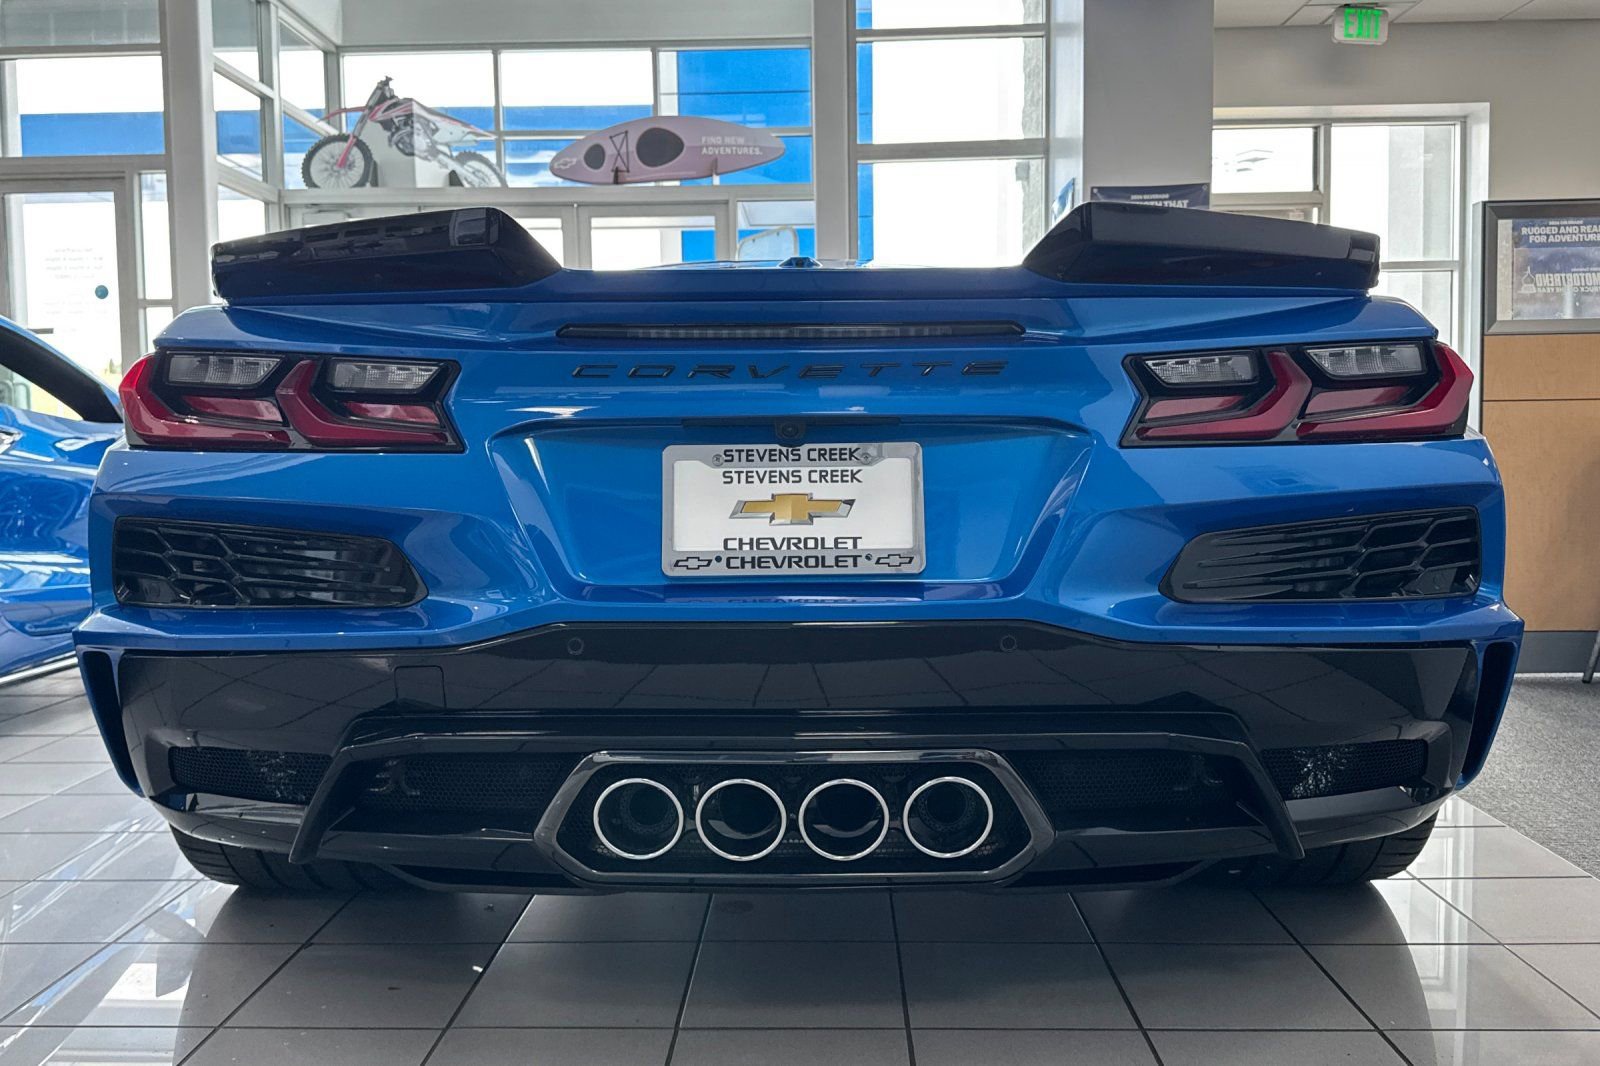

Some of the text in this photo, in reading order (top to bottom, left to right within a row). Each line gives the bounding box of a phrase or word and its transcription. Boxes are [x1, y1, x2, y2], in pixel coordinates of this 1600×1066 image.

[1344, 8, 1383, 39] EXIT
[701, 136, 745, 144] FIND NEW
[702, 146, 763, 155] ADVENTURES.
[1521, 225, 1600, 235] RUGGED AND REA
[1529, 235, 1547, 243] FOR
[572, 361, 1008, 378] CORVETTE
[723, 447, 861, 462] STEVENS CREEK
[723, 469, 863, 484] STEVENS CREEK
[723, 537, 862, 551] CHEVROLET
[725, 555, 862, 569] CHEVROLET
